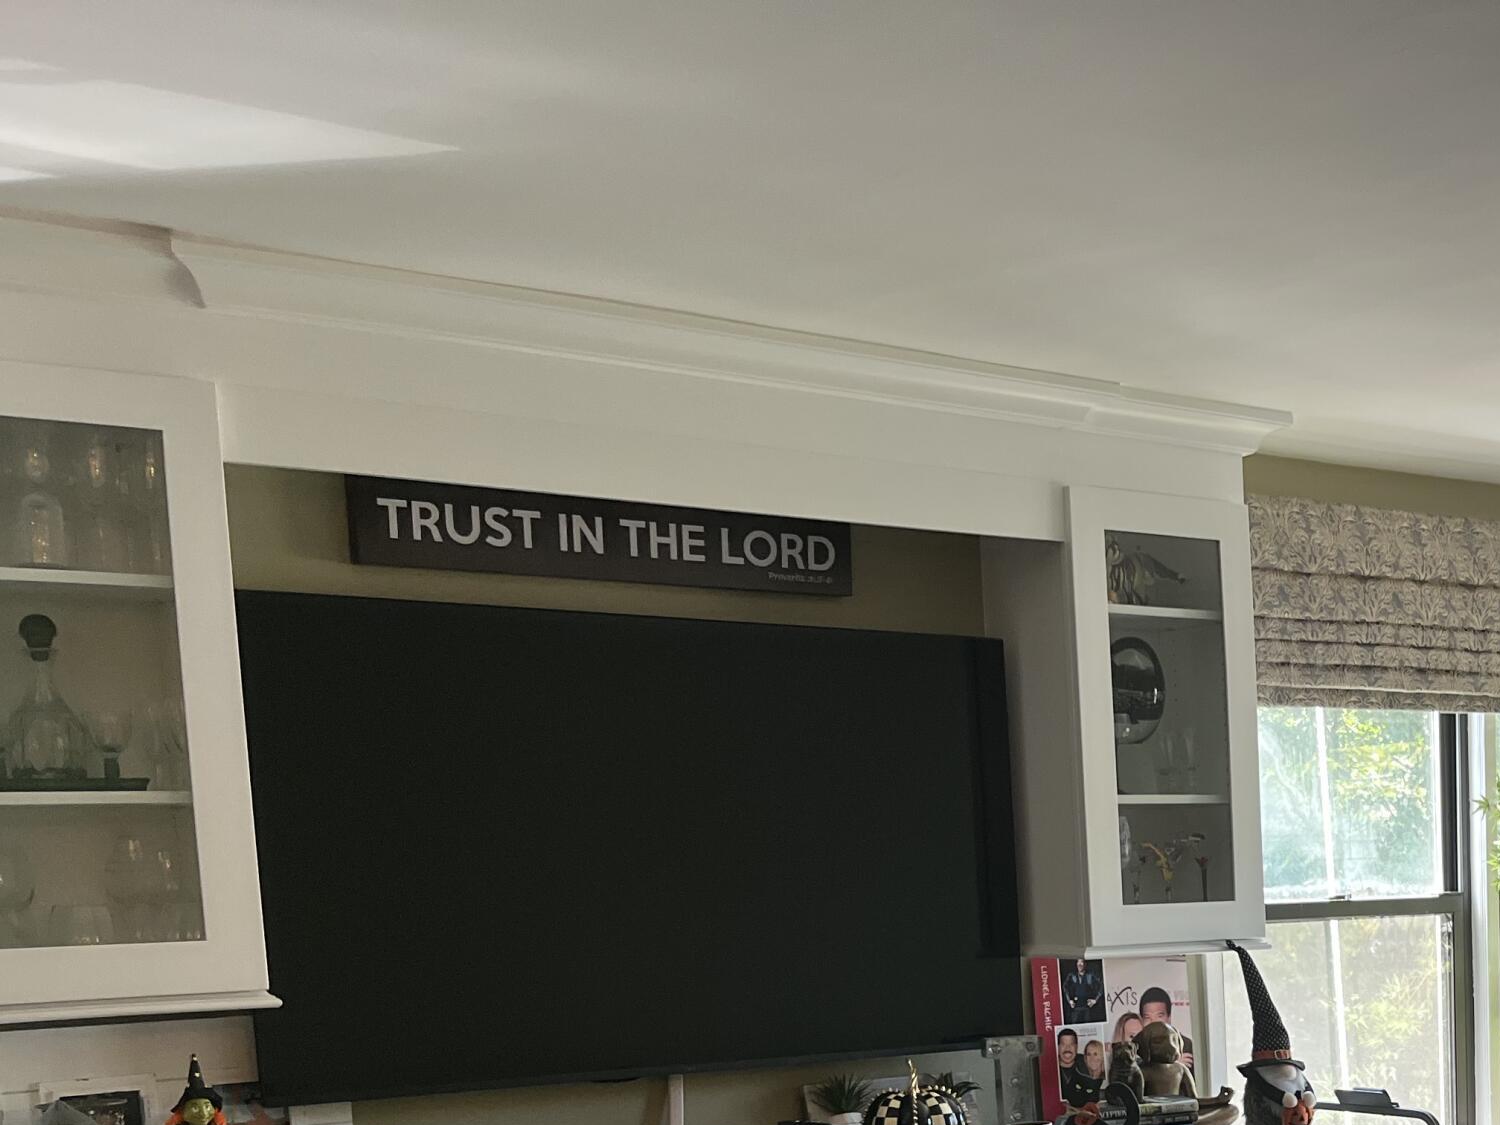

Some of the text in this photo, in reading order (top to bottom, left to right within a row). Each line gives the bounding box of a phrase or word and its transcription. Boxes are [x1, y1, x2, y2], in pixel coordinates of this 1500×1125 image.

[376, 497, 836, 572] TRUST IN THE LORD
